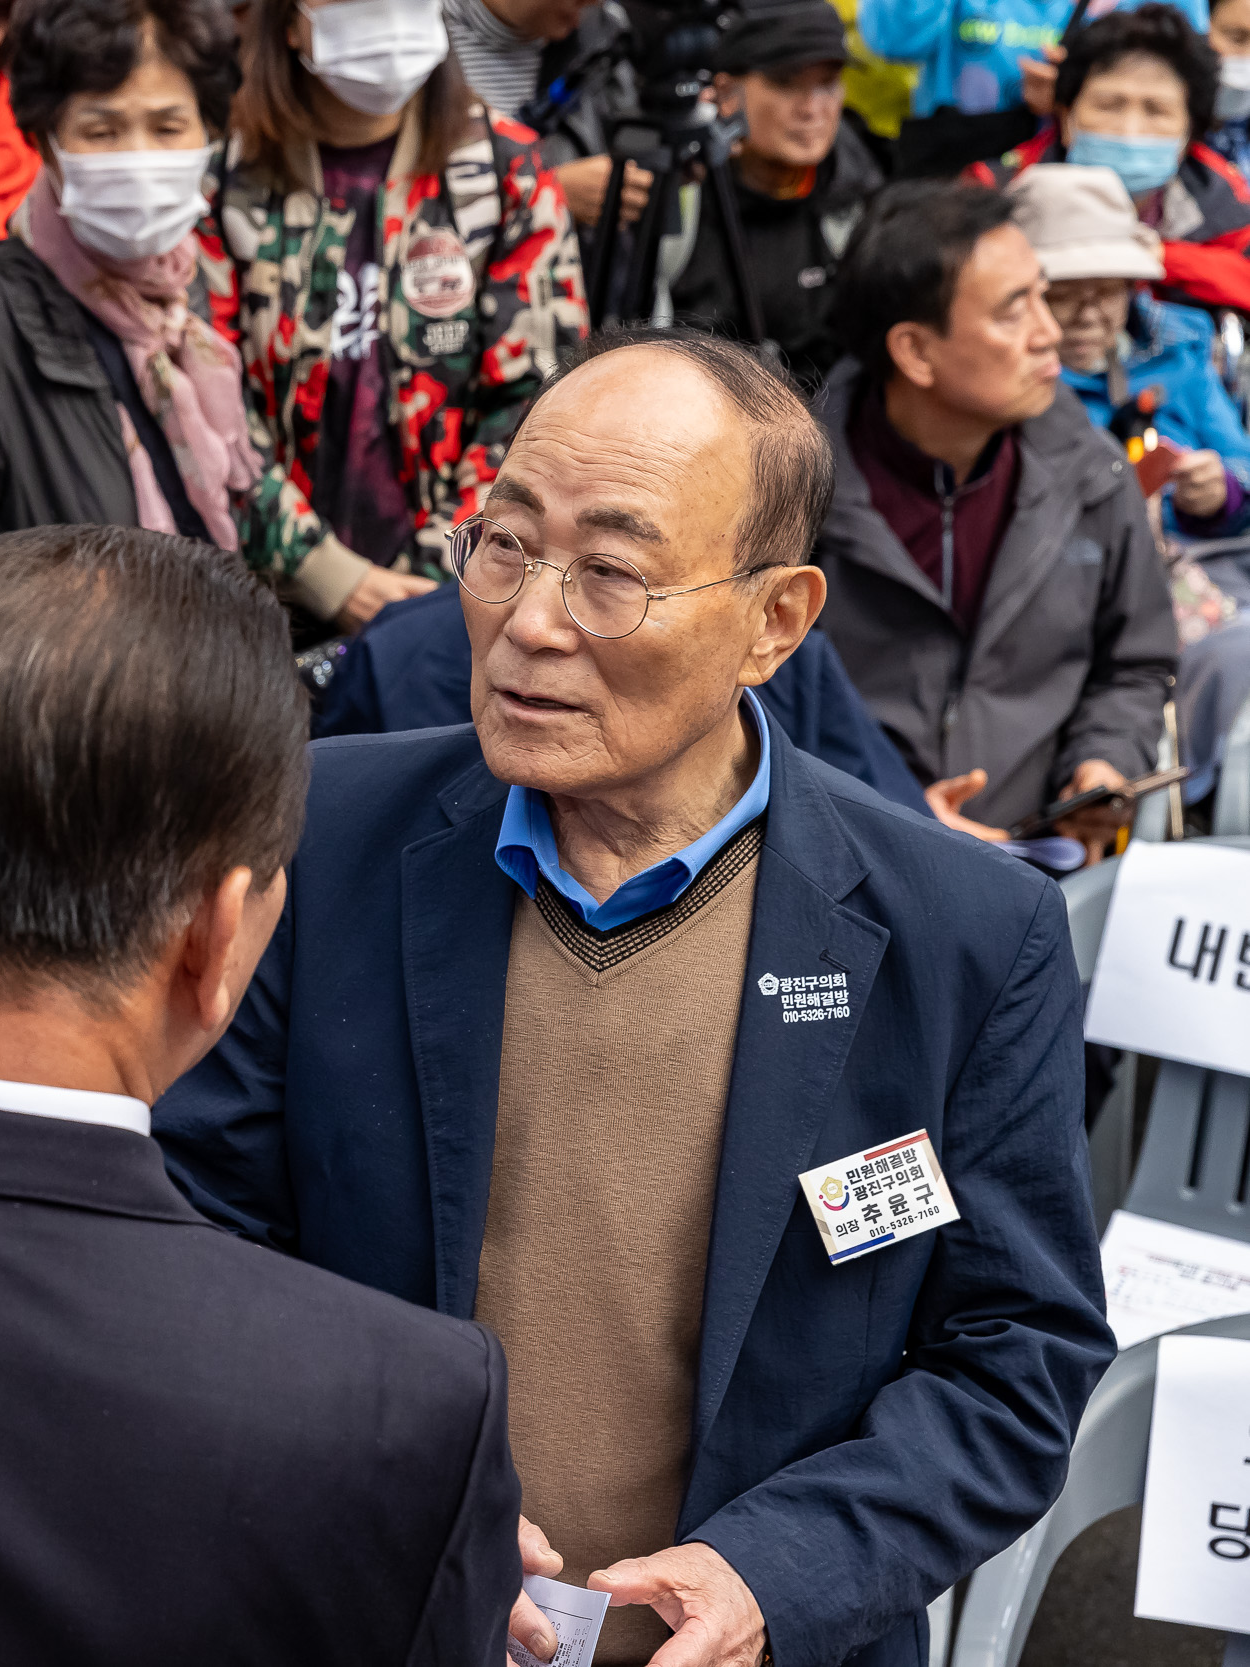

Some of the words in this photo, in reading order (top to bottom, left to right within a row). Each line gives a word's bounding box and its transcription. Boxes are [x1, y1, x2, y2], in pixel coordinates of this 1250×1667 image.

[779, 973, 847, 993] 광진구의회
[781, 990, 849, 1009] 민원해결방
[783, 1006, 850, 1023] 010-5326-7160
[846, 1148, 918, 1185] 민원해결방
[852, 1164, 925, 1202] 광진구의회
[835, 1218, 860, 1238] 의장
[869, 1205, 940, 1238] 010-5326-7160
